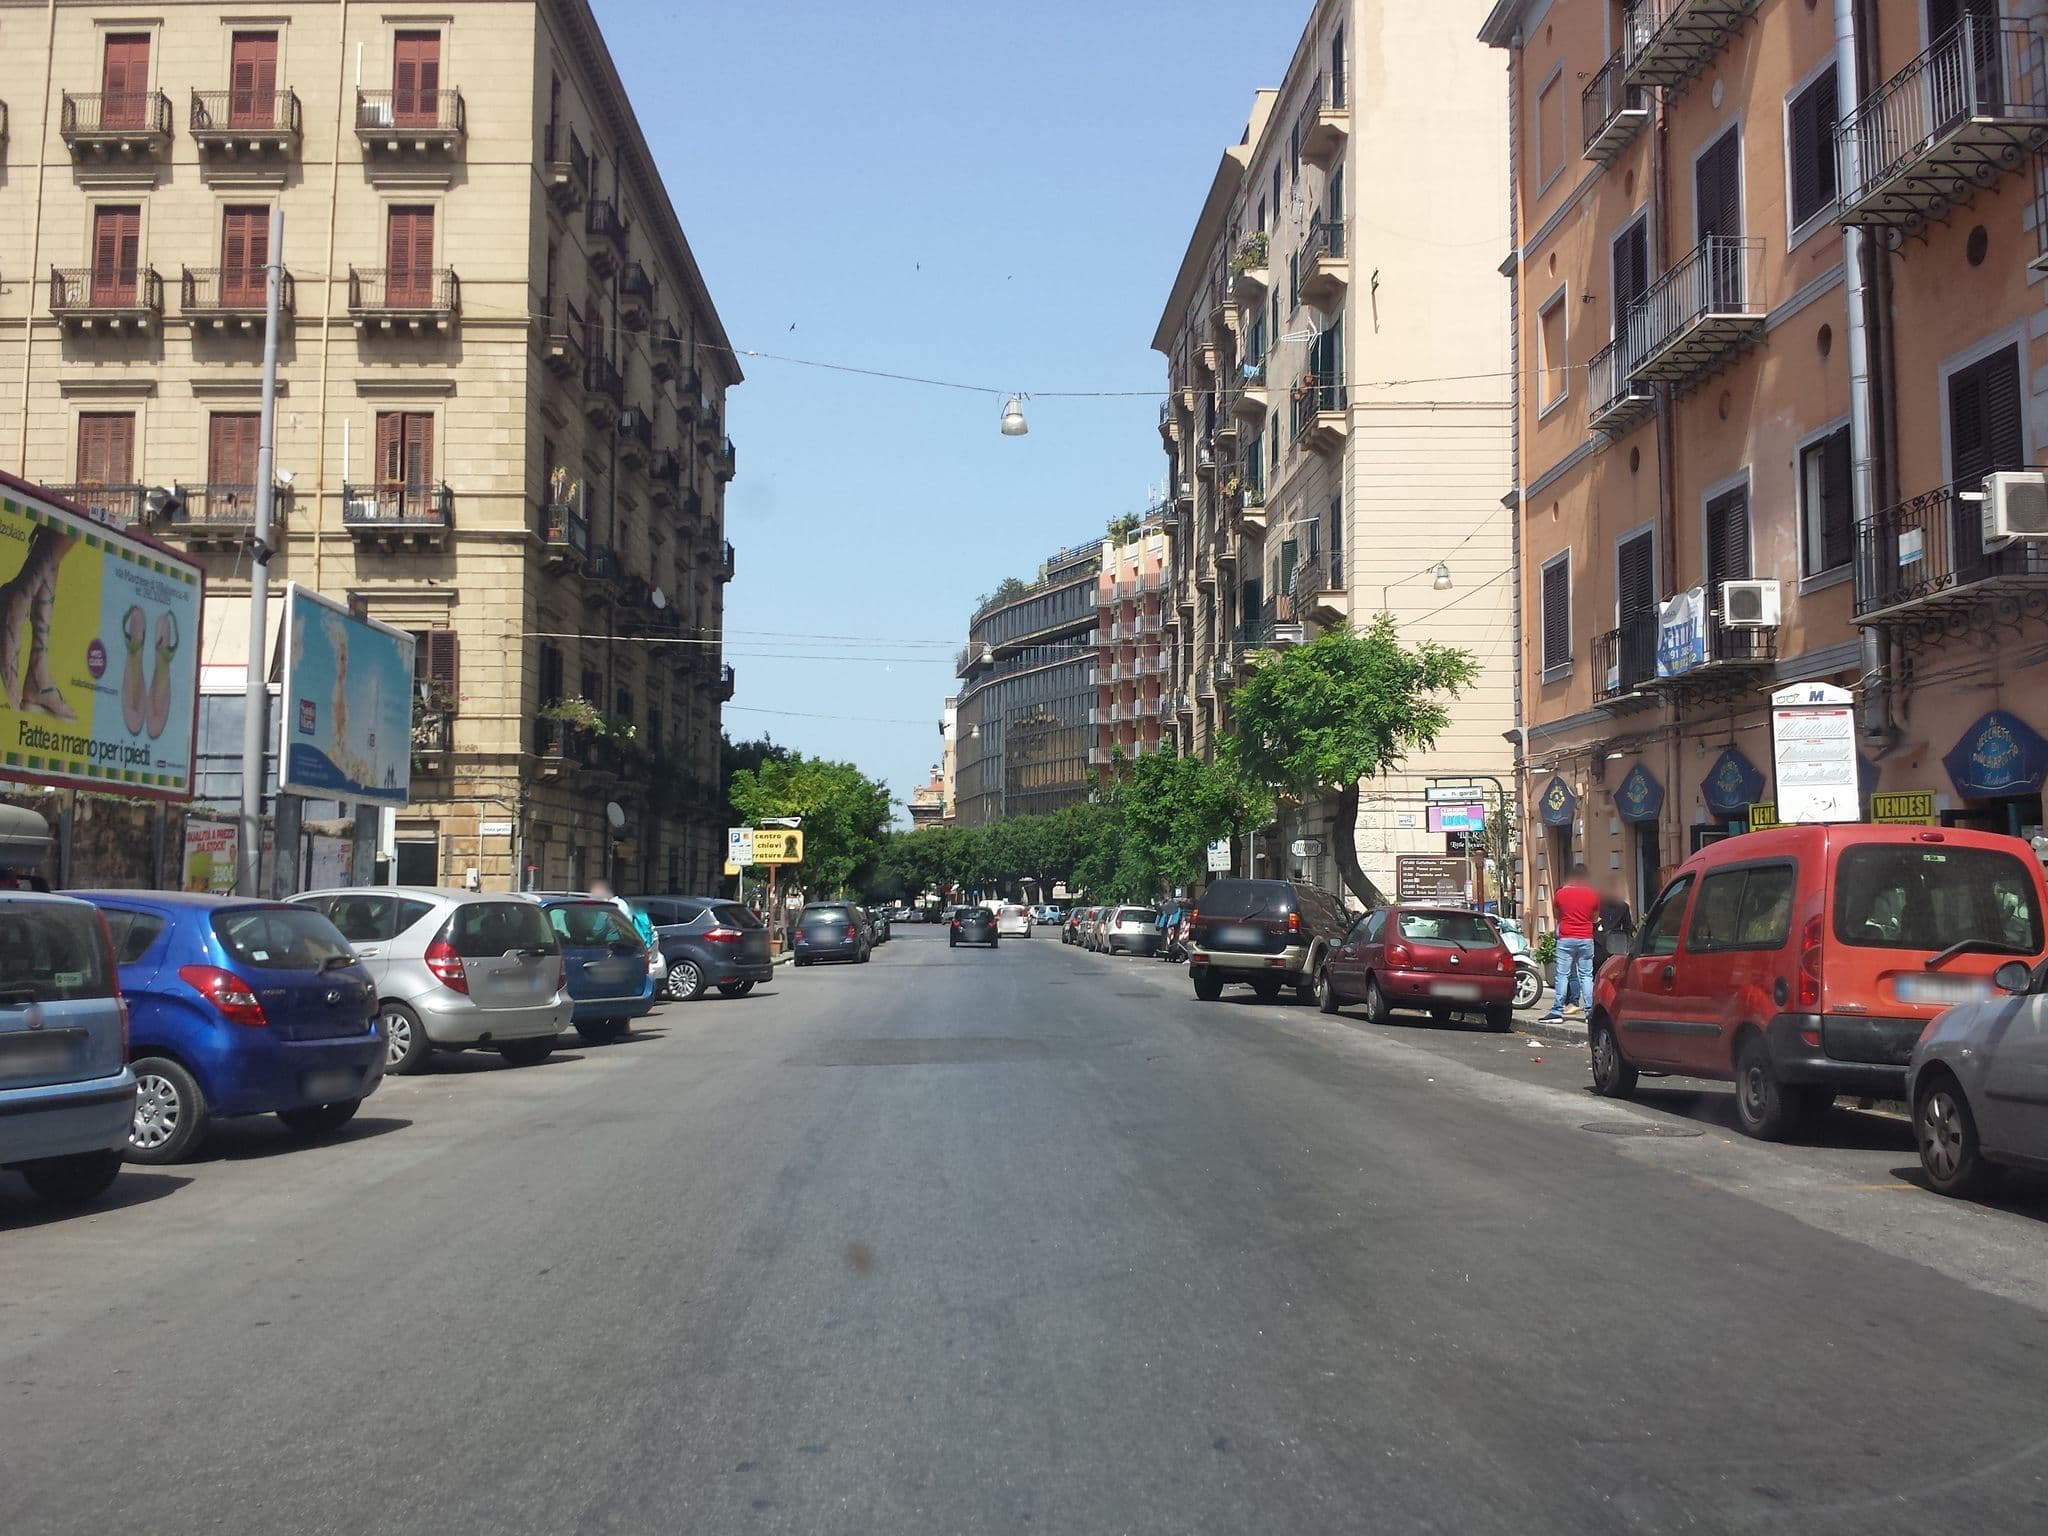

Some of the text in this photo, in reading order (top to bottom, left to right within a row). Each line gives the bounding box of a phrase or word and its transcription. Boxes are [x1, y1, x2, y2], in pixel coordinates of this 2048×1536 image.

[18, 720, 50, 751] Fatte
[51, 739, 60, 752] a
[61, 735, 98, 758] mano
[99, 742, 119, 765] per
[125, 741, 151, 768] piedi
[1876, 796, 1930, 817] VENDESI
